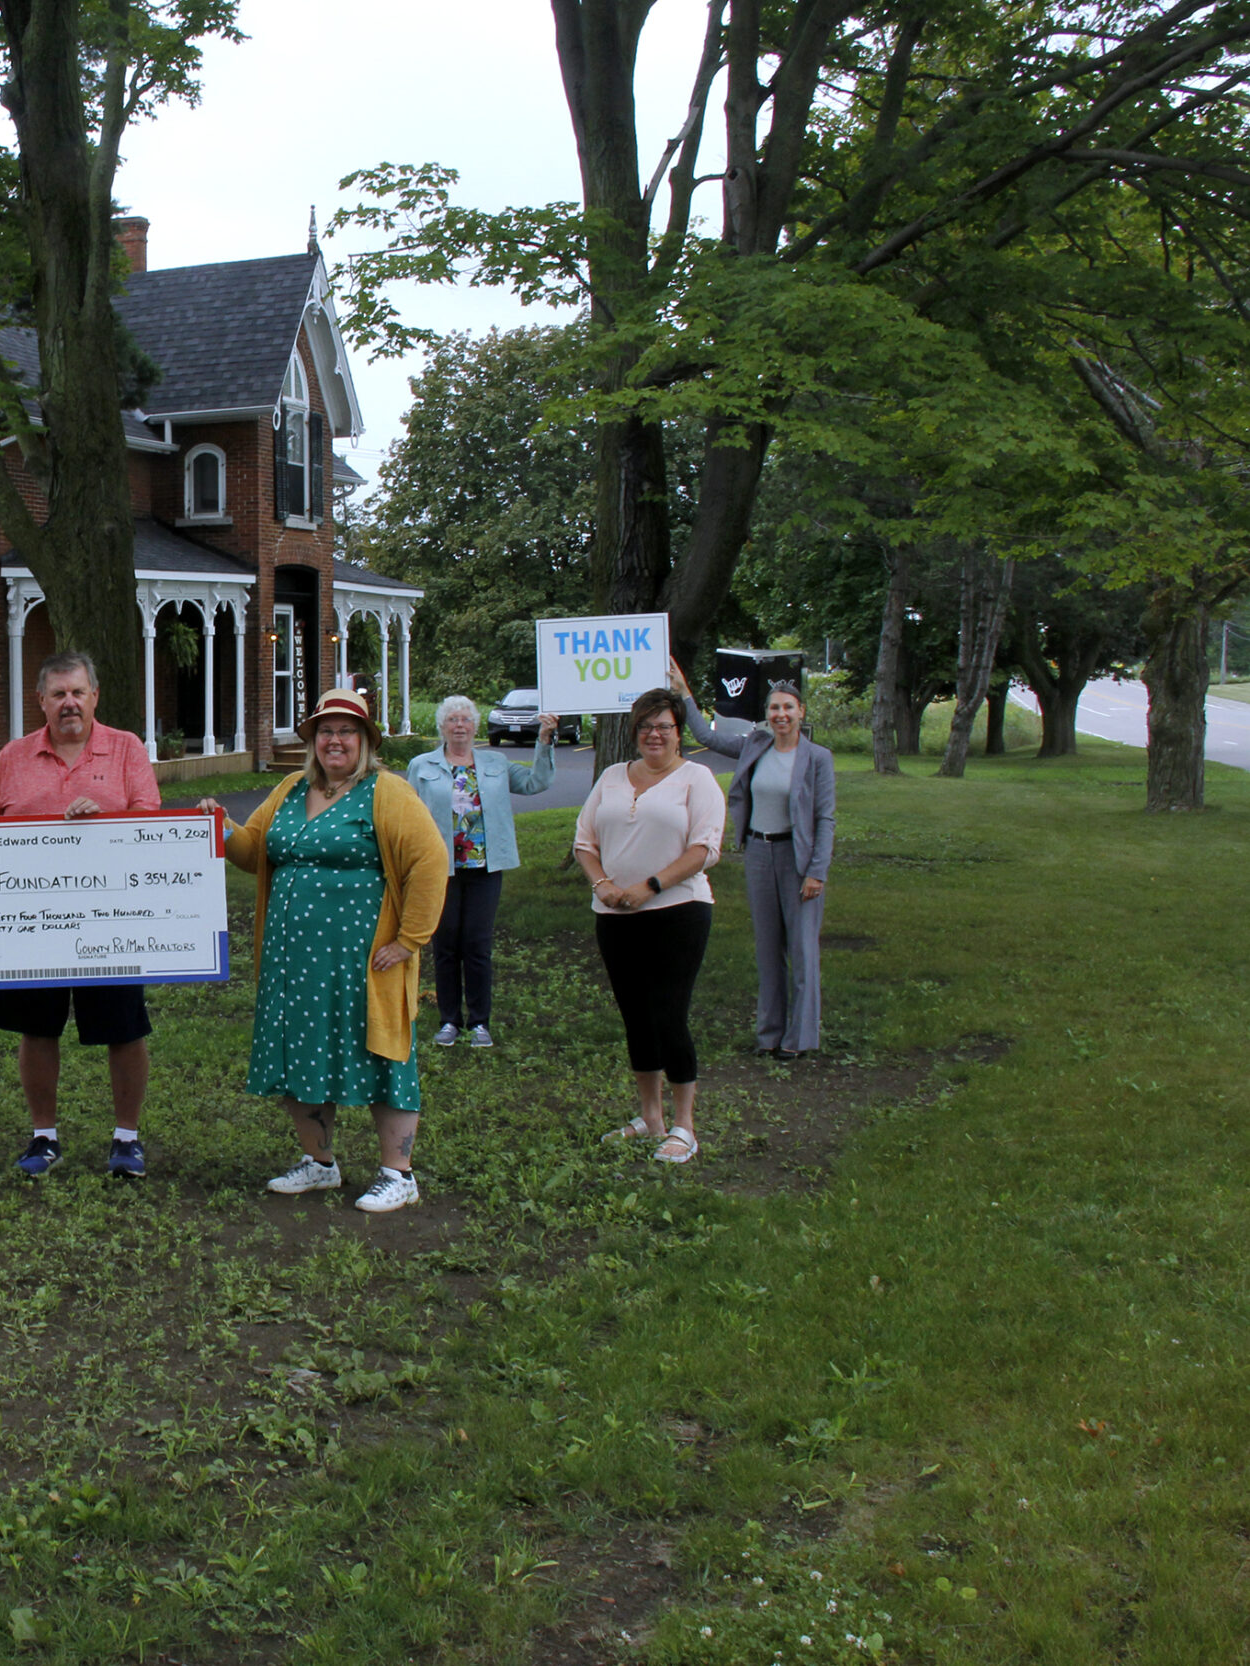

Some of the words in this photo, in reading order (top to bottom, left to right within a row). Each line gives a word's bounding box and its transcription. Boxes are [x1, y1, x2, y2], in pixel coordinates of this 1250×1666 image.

[553, 627, 652, 655] THANK
[294, 635, 306, 713] WELCOME
[573, 656, 632, 682] YOU
[41, 835, 82, 845] County
[168, 827, 182, 840] 9,
[184, 828, 209, 839] 2021
[129, 873, 139, 888] $
[39, 908, 86, 920] THOUSAND
[113, 908, 155, 918] HUNDRED
[17, 925, 36, 933] ONE
[42, 922, 81, 931] DOLLARS
[147, 936, 196, 953] REALTORS
